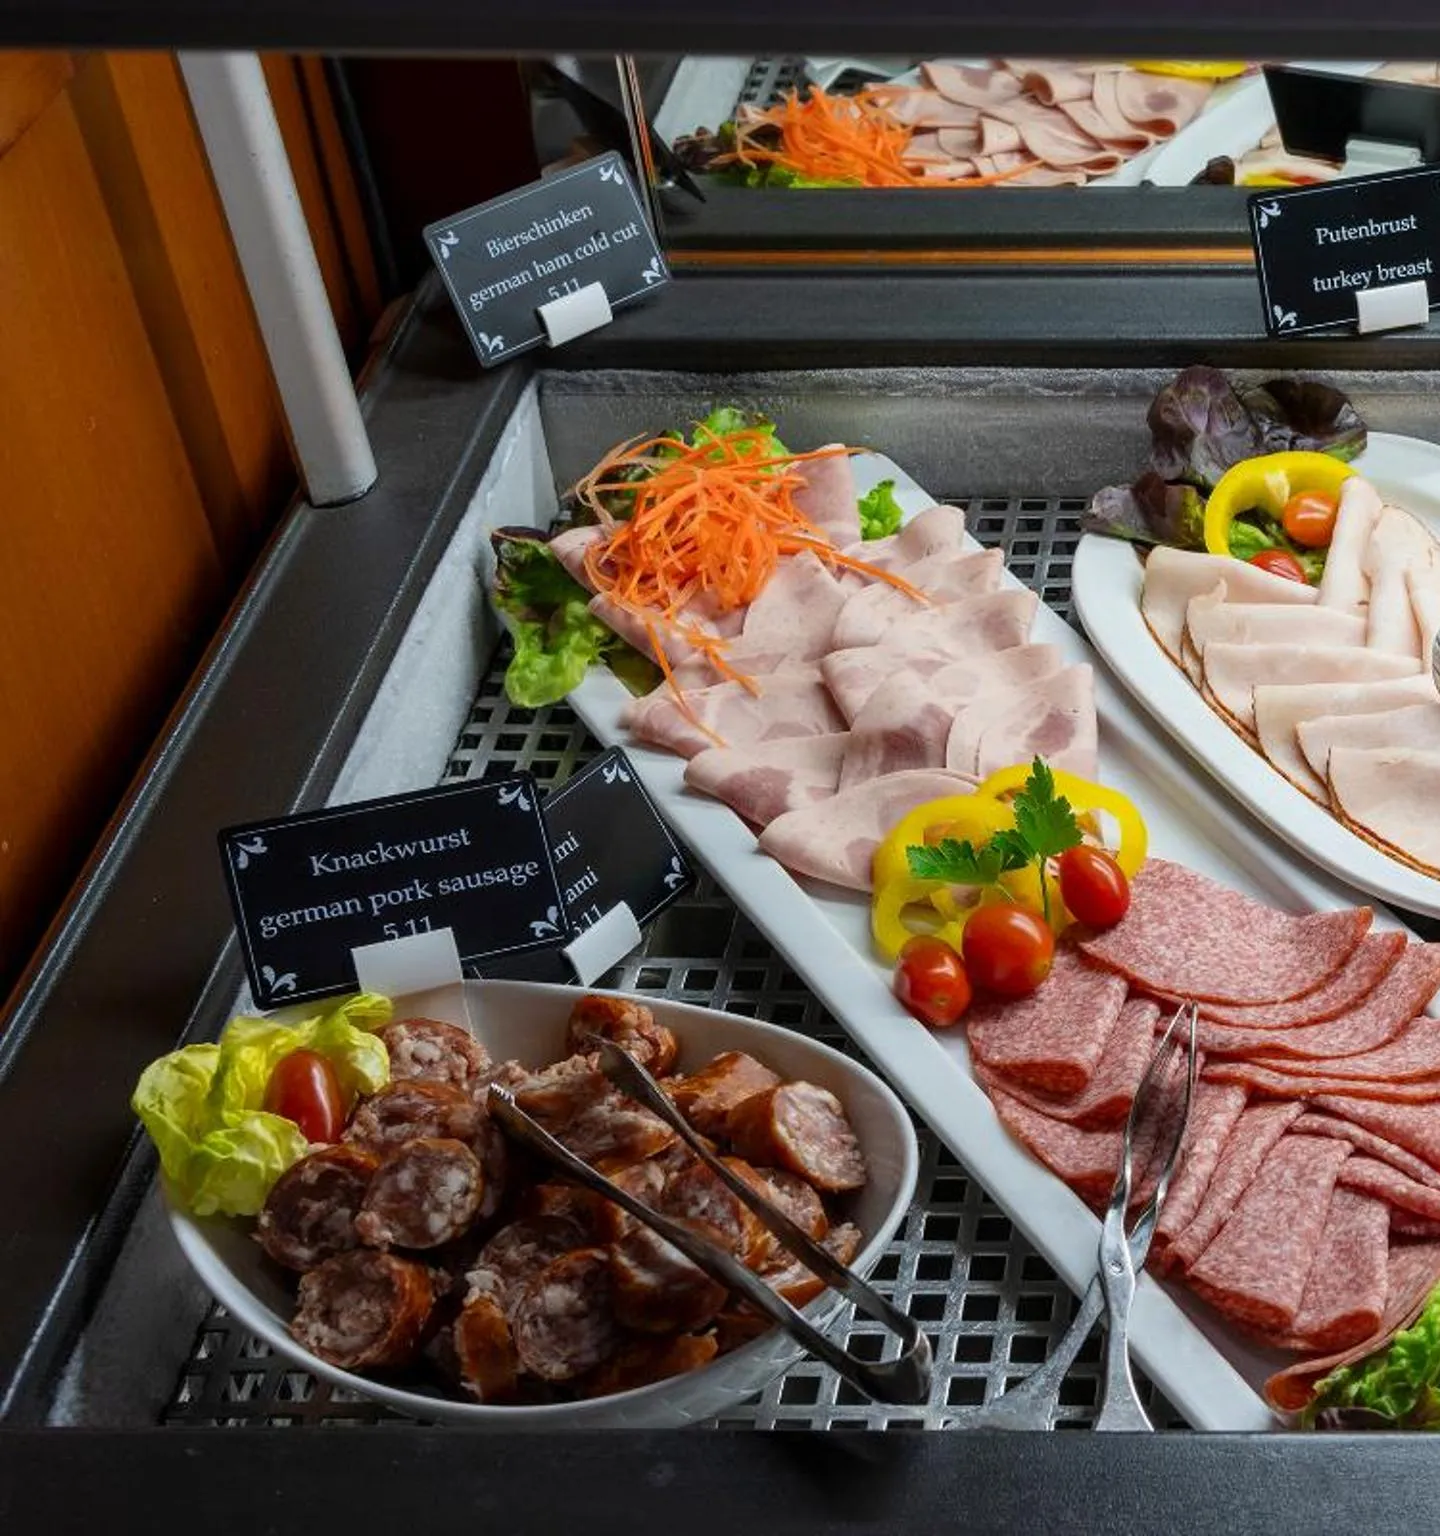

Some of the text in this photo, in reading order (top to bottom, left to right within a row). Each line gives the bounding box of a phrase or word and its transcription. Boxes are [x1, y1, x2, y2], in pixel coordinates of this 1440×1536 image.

[486, 205, 593, 258] Bierschinken
[1315, 214, 1417, 245] Putenbrust
[469, 221, 640, 312] german ham cold cut
[1313, 257, 1433, 292] turkey breast
[310, 828, 471, 877] Knackwurst
[259, 859, 540, 937] german pork sausage
